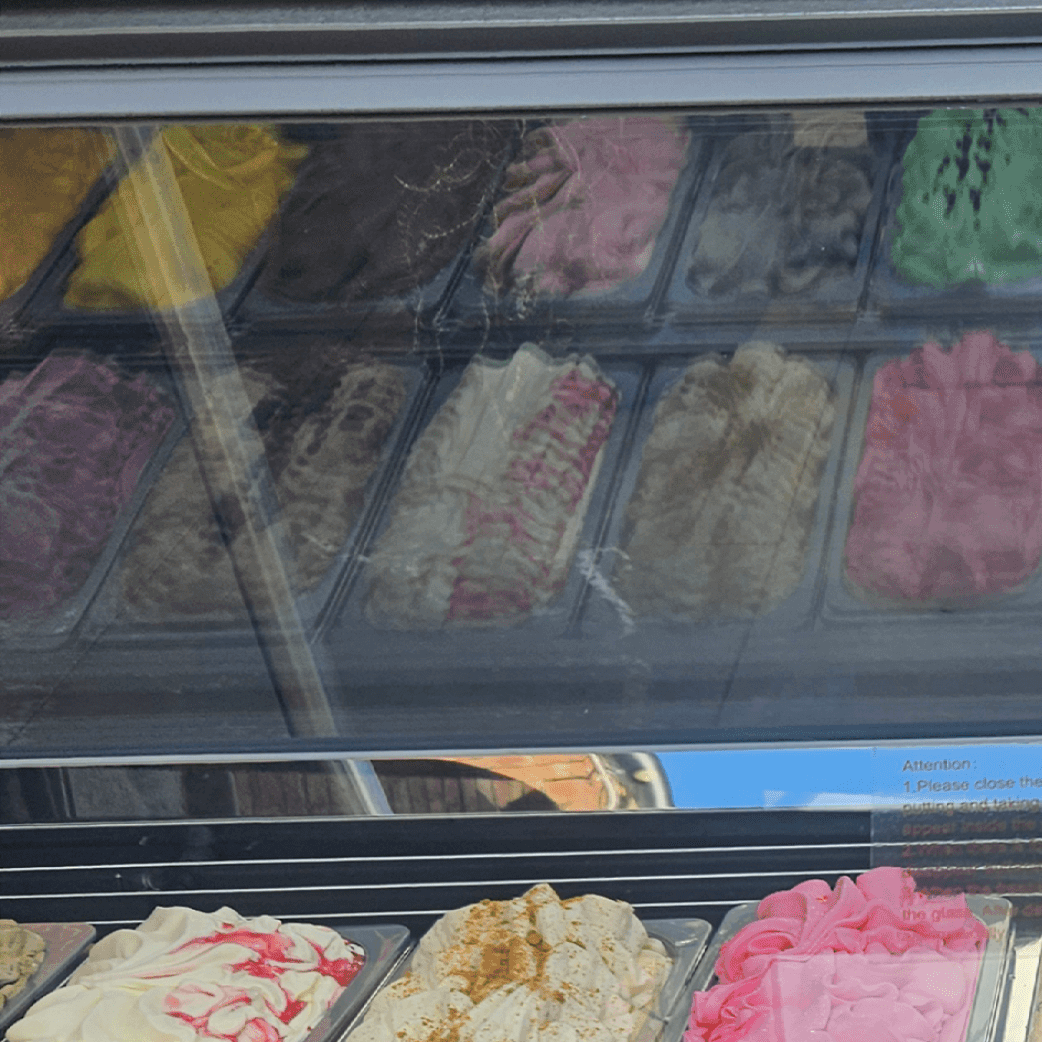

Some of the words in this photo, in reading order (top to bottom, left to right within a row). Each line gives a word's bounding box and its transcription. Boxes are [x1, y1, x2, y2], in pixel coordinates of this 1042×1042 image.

[974, 777, 1016, 790] close
[902, 801, 954, 817] putting
[960, 798, 989, 812] and
[994, 797, 1040, 813] taking
